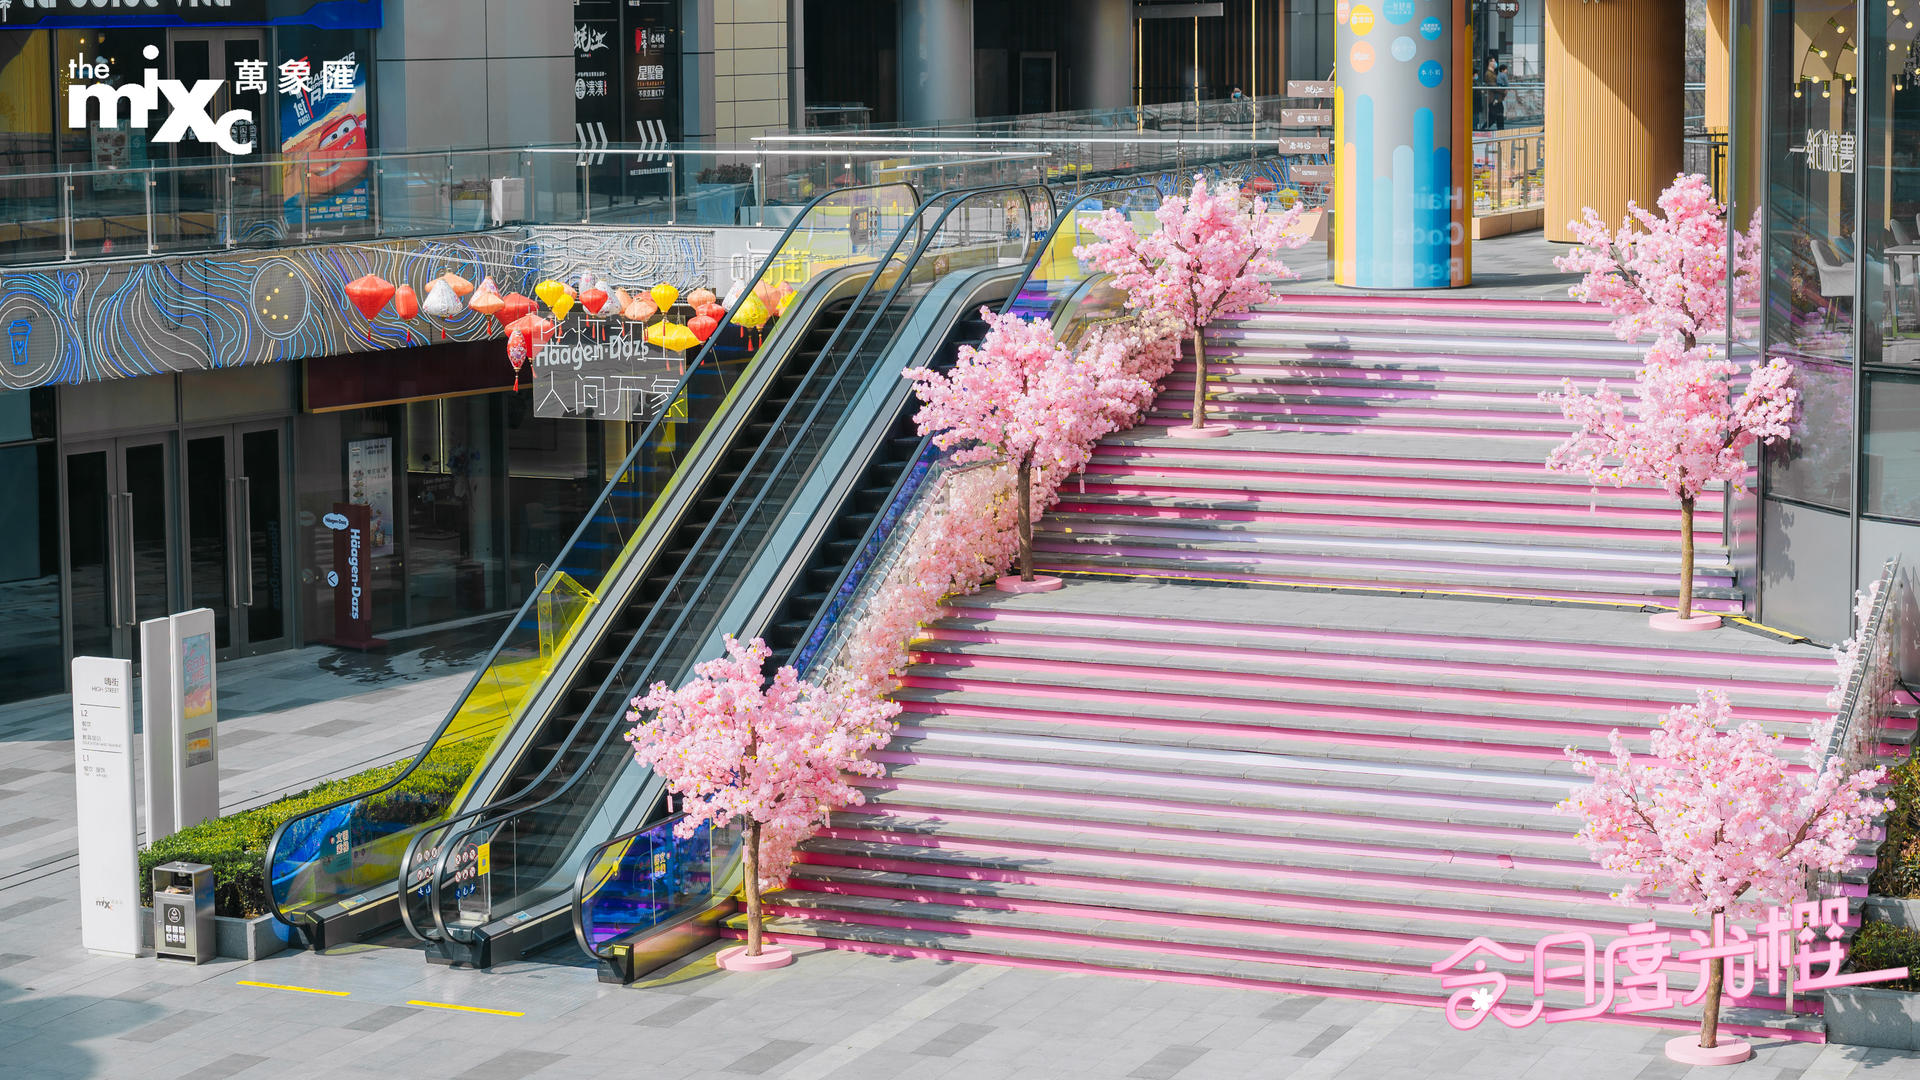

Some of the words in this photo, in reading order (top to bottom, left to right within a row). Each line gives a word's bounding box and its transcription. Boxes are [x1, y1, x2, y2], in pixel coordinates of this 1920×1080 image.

[293, 98, 308, 118] 1st
[537, 371, 686, 418] 人间万象
[81, 709, 88, 717] L2
